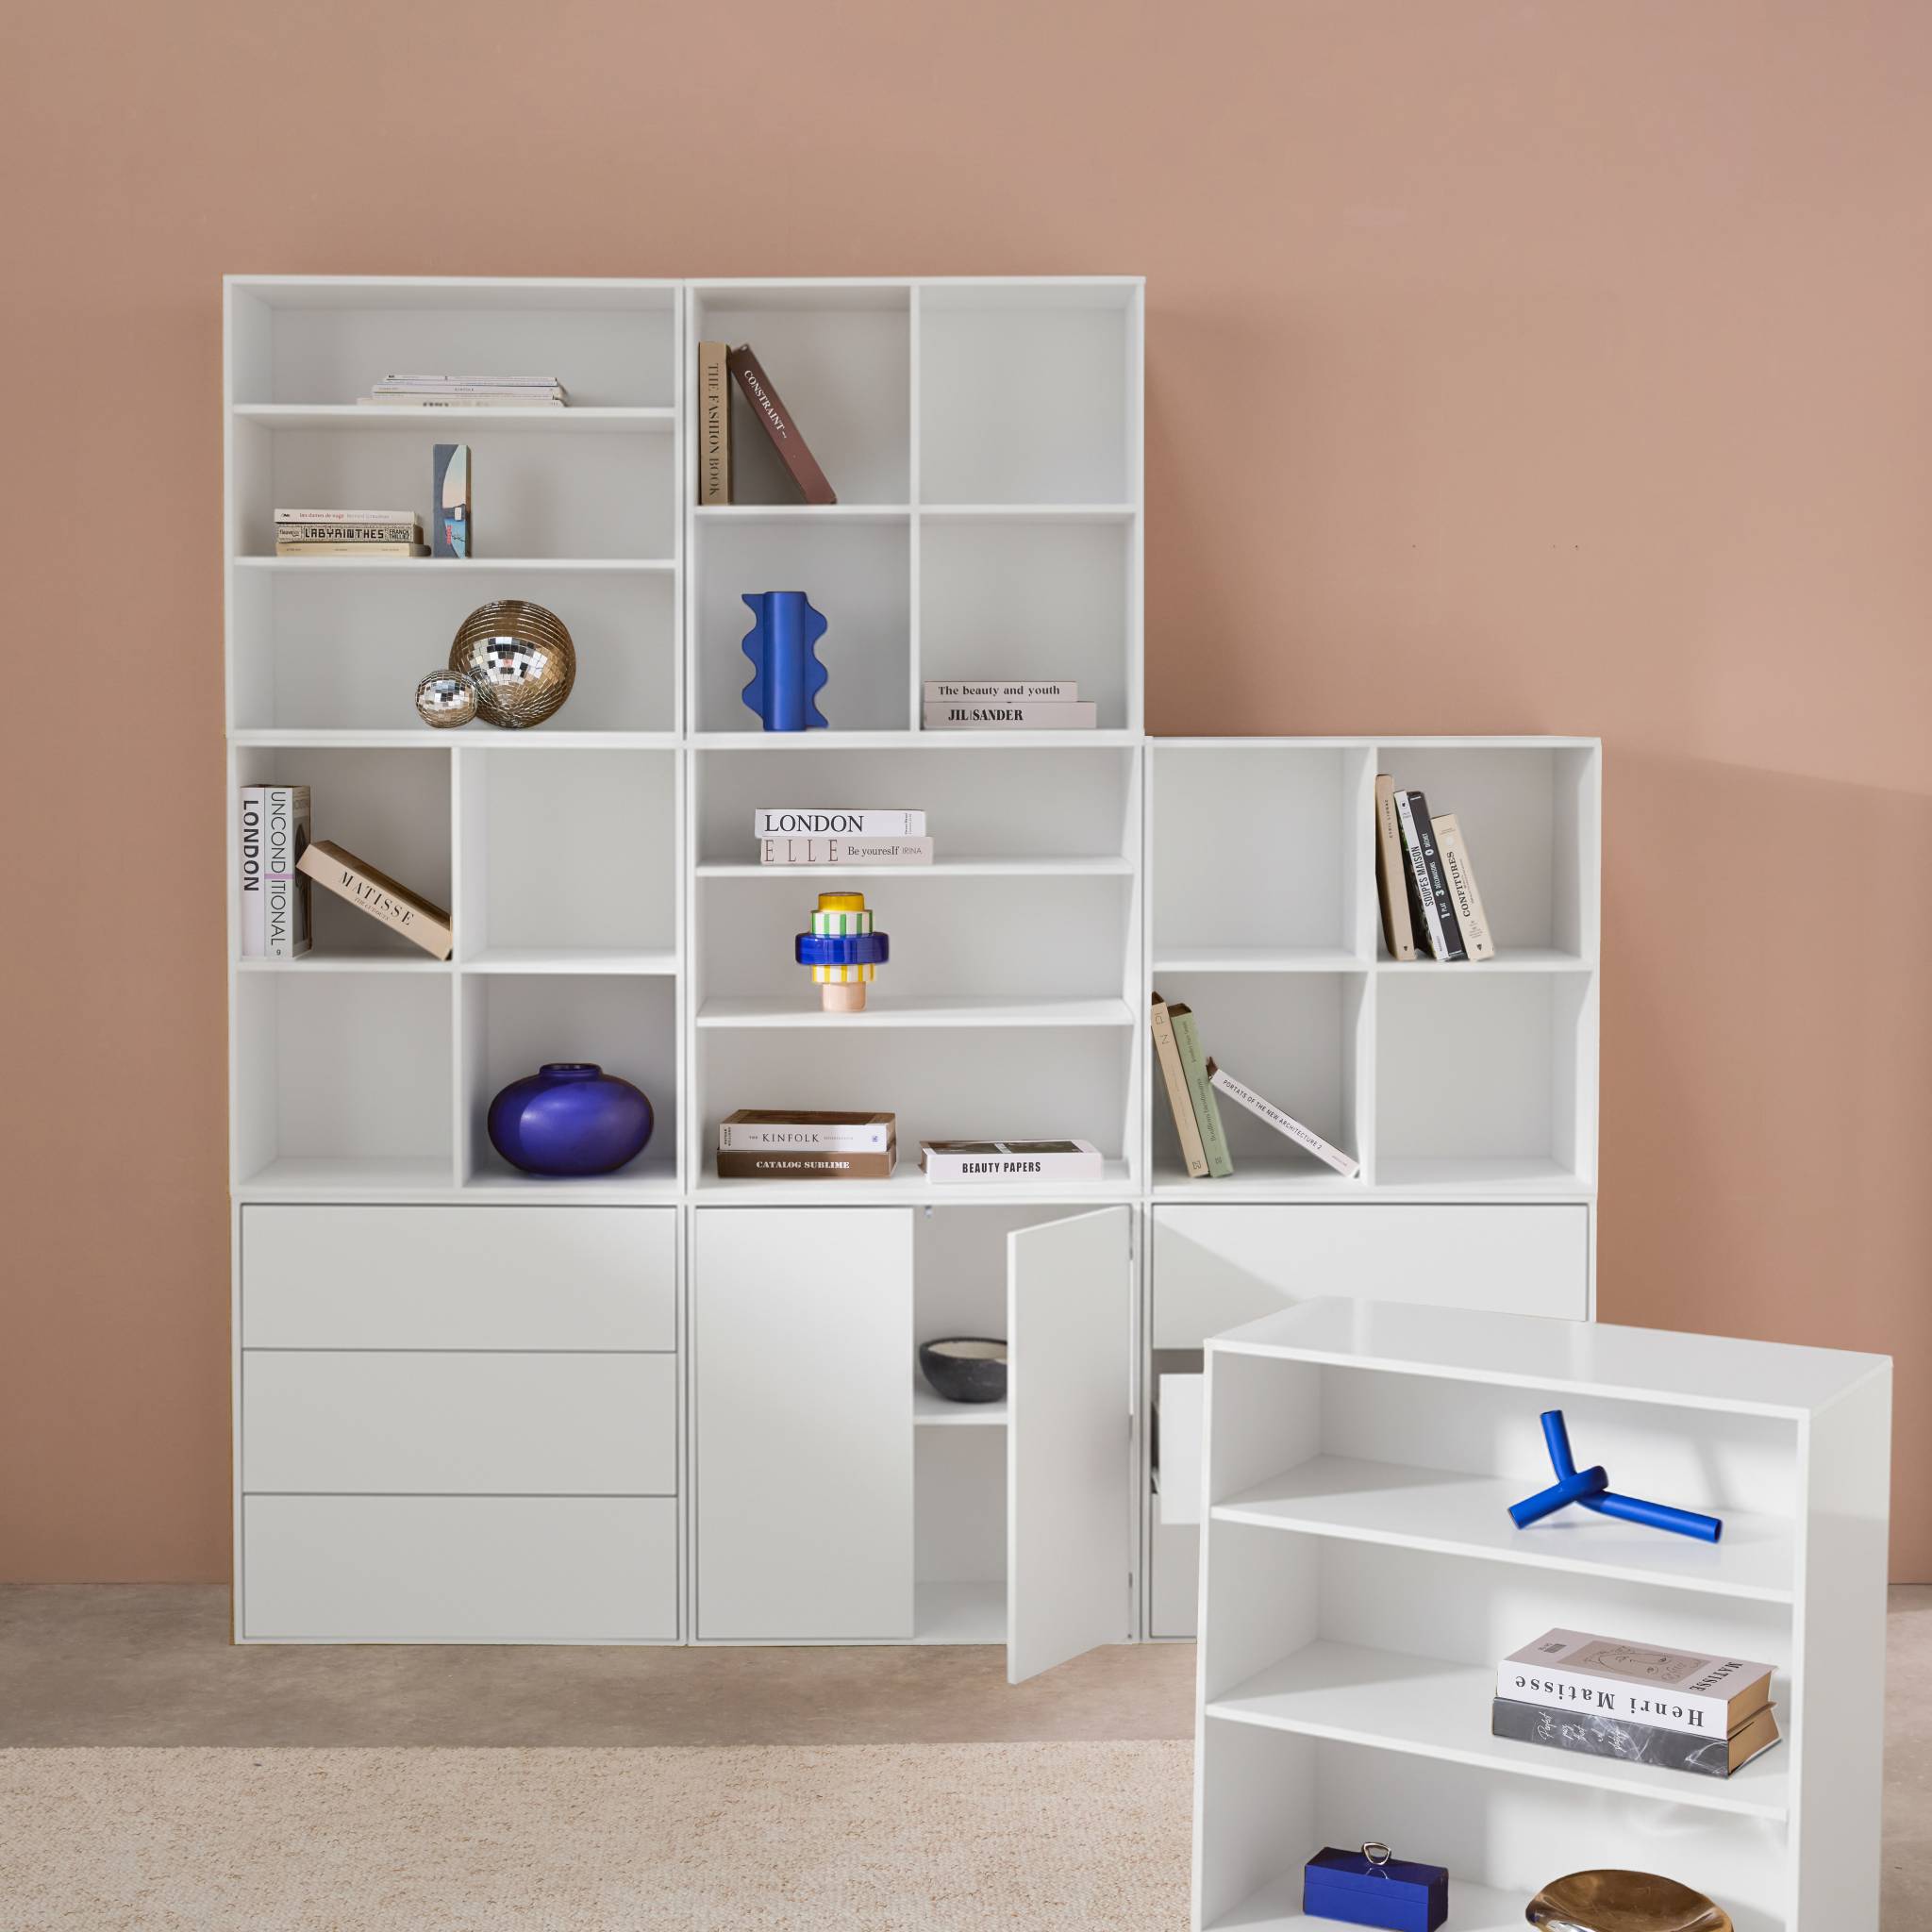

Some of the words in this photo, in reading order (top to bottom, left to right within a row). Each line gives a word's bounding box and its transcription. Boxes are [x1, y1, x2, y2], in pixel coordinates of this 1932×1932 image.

[708, 363, 719, 391] THE
[744, 370, 785, 430] CONSTRAINT
[708, 394, 720, 454] FASHION
[709, 458, 721, 497] BOOK
[938, 686, 958, 695] The
[962, 685, 999, 697] beauty
[1003, 685, 1024, 695] and
[1028, 685, 1060, 697] youth
[948, 708, 969, 721] JIL
[973, 708, 1024, 721] SANDER
[765, 814, 864, 832] LONDON
[243, 800, 259, 891] LONDON
[763, 840, 839, 862] ELLE
[848, 846, 859, 856] Be
[1411, 845, 1426, 876] MAISON
[339, 871, 415, 926] MATISSE
[1419, 876, 1434, 908] SOUPES
[1446, 851, 1471, 918] CONFITURES
[761, 1133, 820, 1143] KINFOLK
[1256, 1101, 1267, 1112] THE
[1266, 1108, 1279, 1121] NEW
[1278, 1118, 1319, 1148] ARCHITECTURE
[804, 1161, 851, 1170] SUBLIME
[962, 1162, 1000, 1174] BEAUTY
[1003, 1161, 1041, 1173] PAPERS
[1688, 1661, 1744, 1691] MATISSE
[1514, 1675, 1616, 1710] Matisse
[1629, 1697, 1705, 1727] Henri
